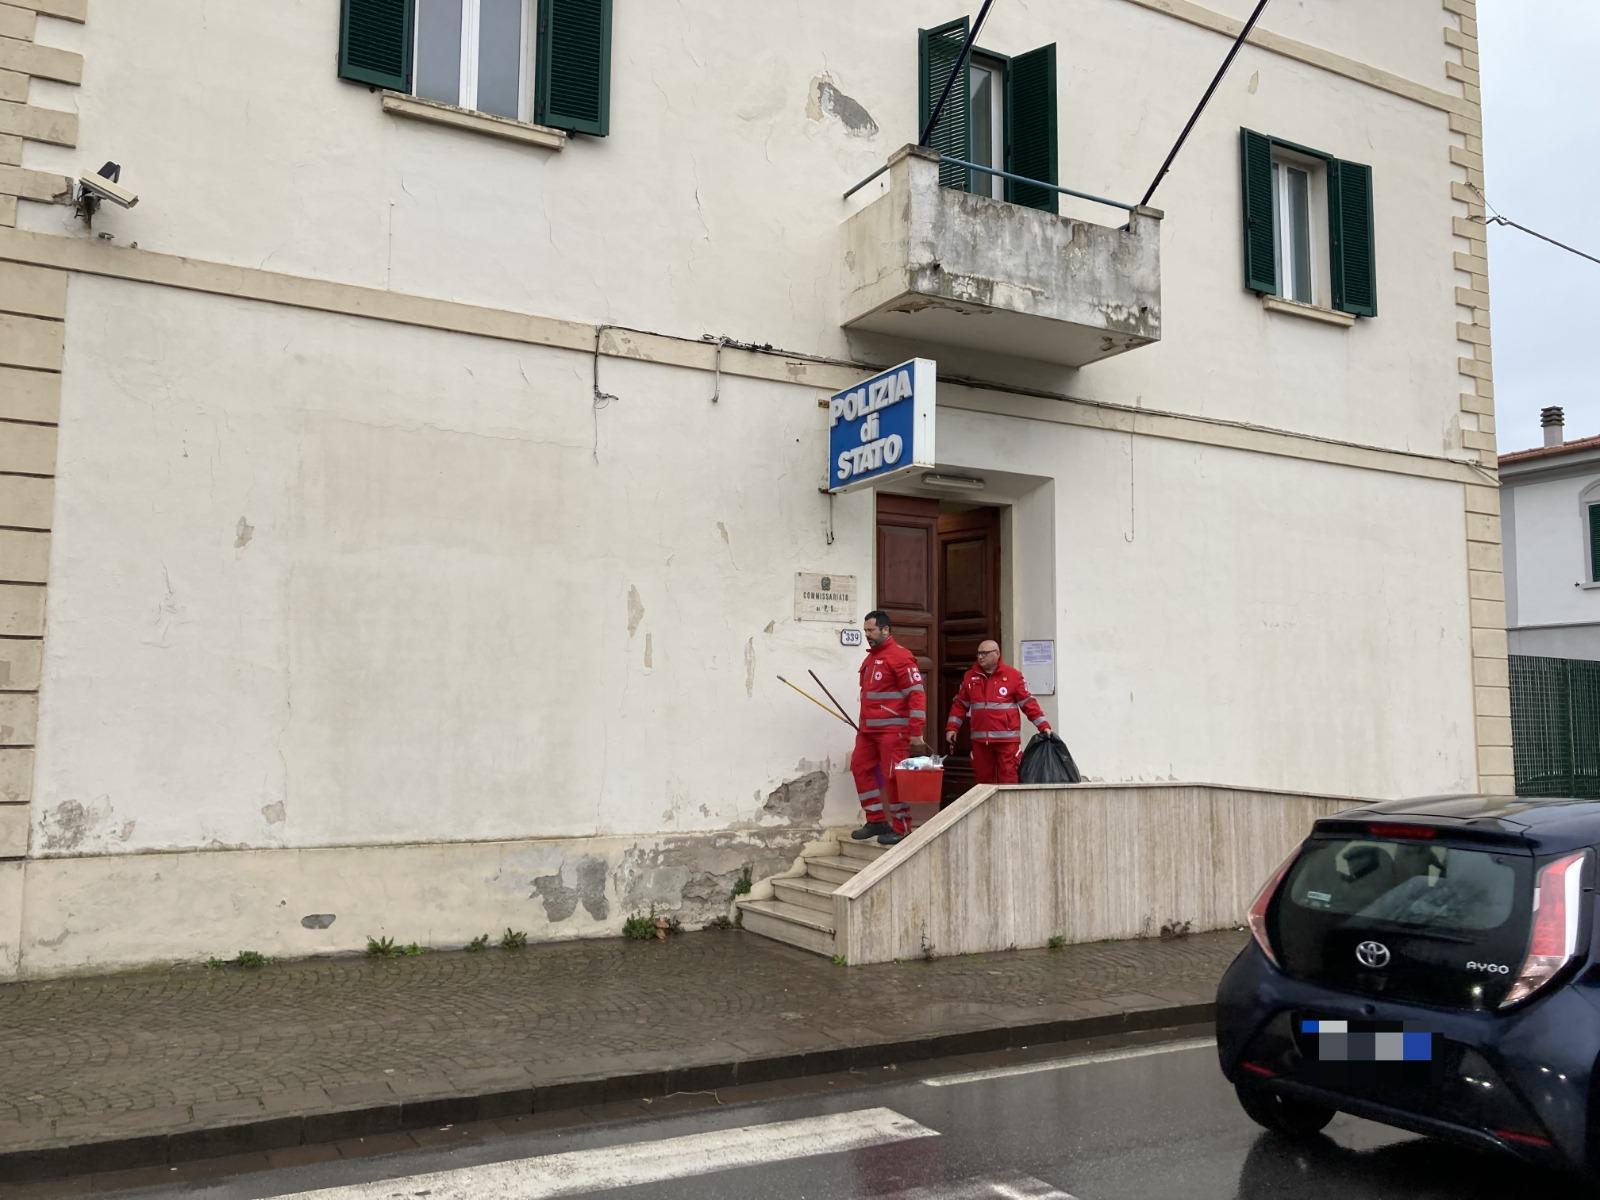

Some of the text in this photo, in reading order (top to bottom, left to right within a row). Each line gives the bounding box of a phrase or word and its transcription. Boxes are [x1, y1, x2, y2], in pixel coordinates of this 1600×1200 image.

[830, 370, 912, 427] POLIZIA
[860, 412, 880, 443] di
[837, 434, 903, 480] STATO
[803, 591, 849, 601] COMMISSARIATO
[845, 632, 859, 641] 339
[1466, 961, 1510, 974] AYGO
